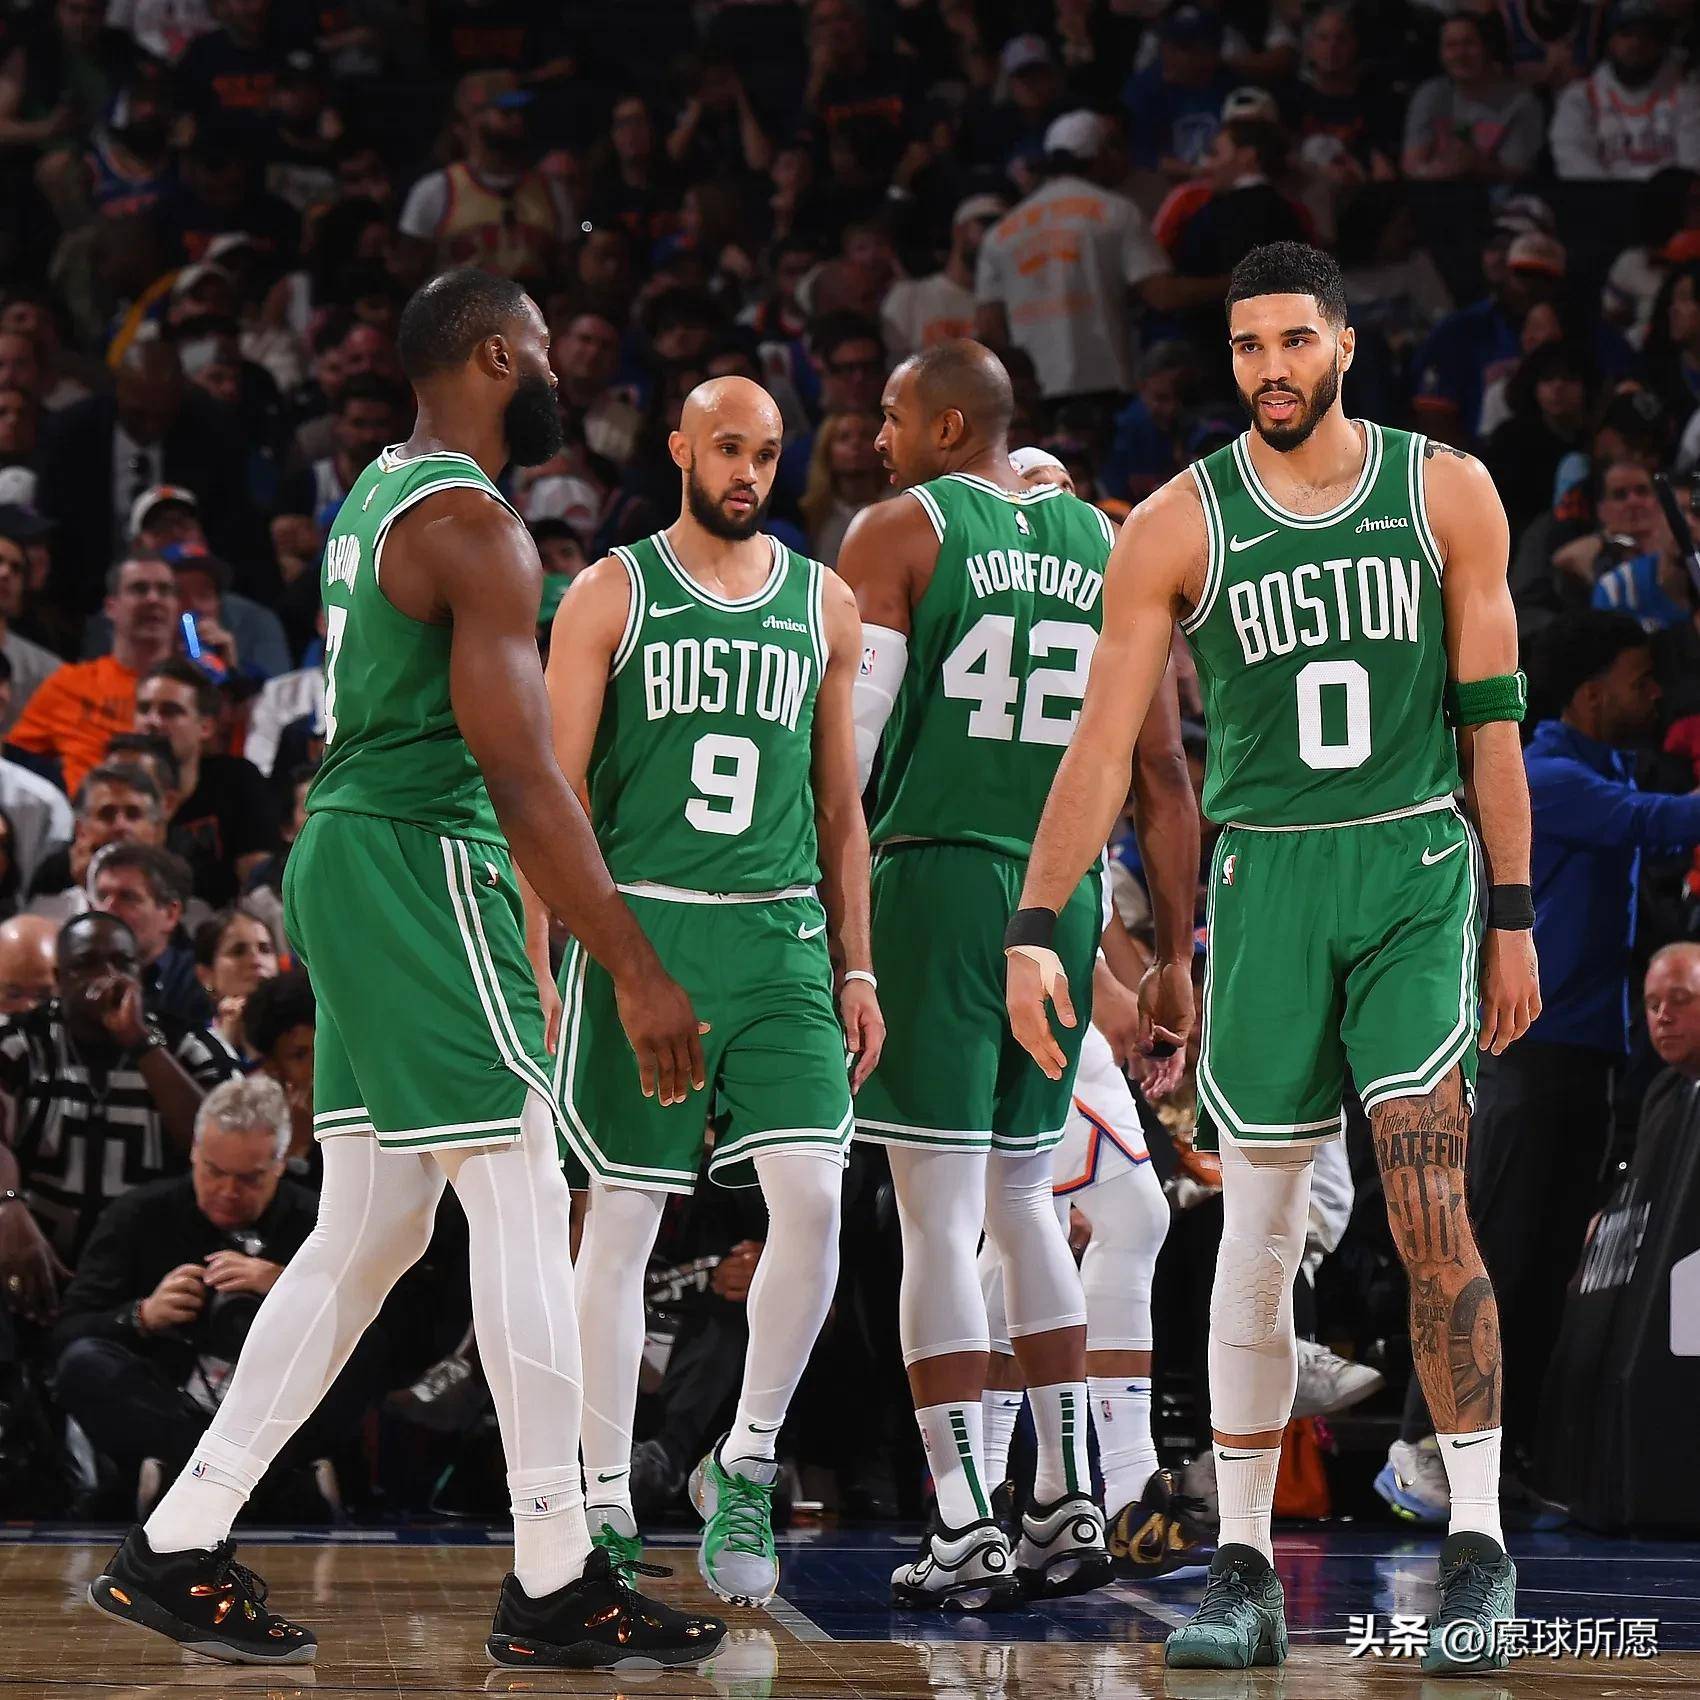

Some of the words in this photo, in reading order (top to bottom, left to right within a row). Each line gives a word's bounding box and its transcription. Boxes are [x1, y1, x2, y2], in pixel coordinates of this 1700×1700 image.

[1355, 516, 1408, 533] Amica
[762, 615, 808, 633] Amica
[966, 549, 1103, 611] HORFORD
[1228, 556, 1420, 664] BOSTON
[325, 604, 347, 744] 7
[643, 637, 811, 732] BOSTON
[942, 614, 1099, 745] 42
[1296, 659, 1372, 769] 0
[684, 733, 760, 836] 9
